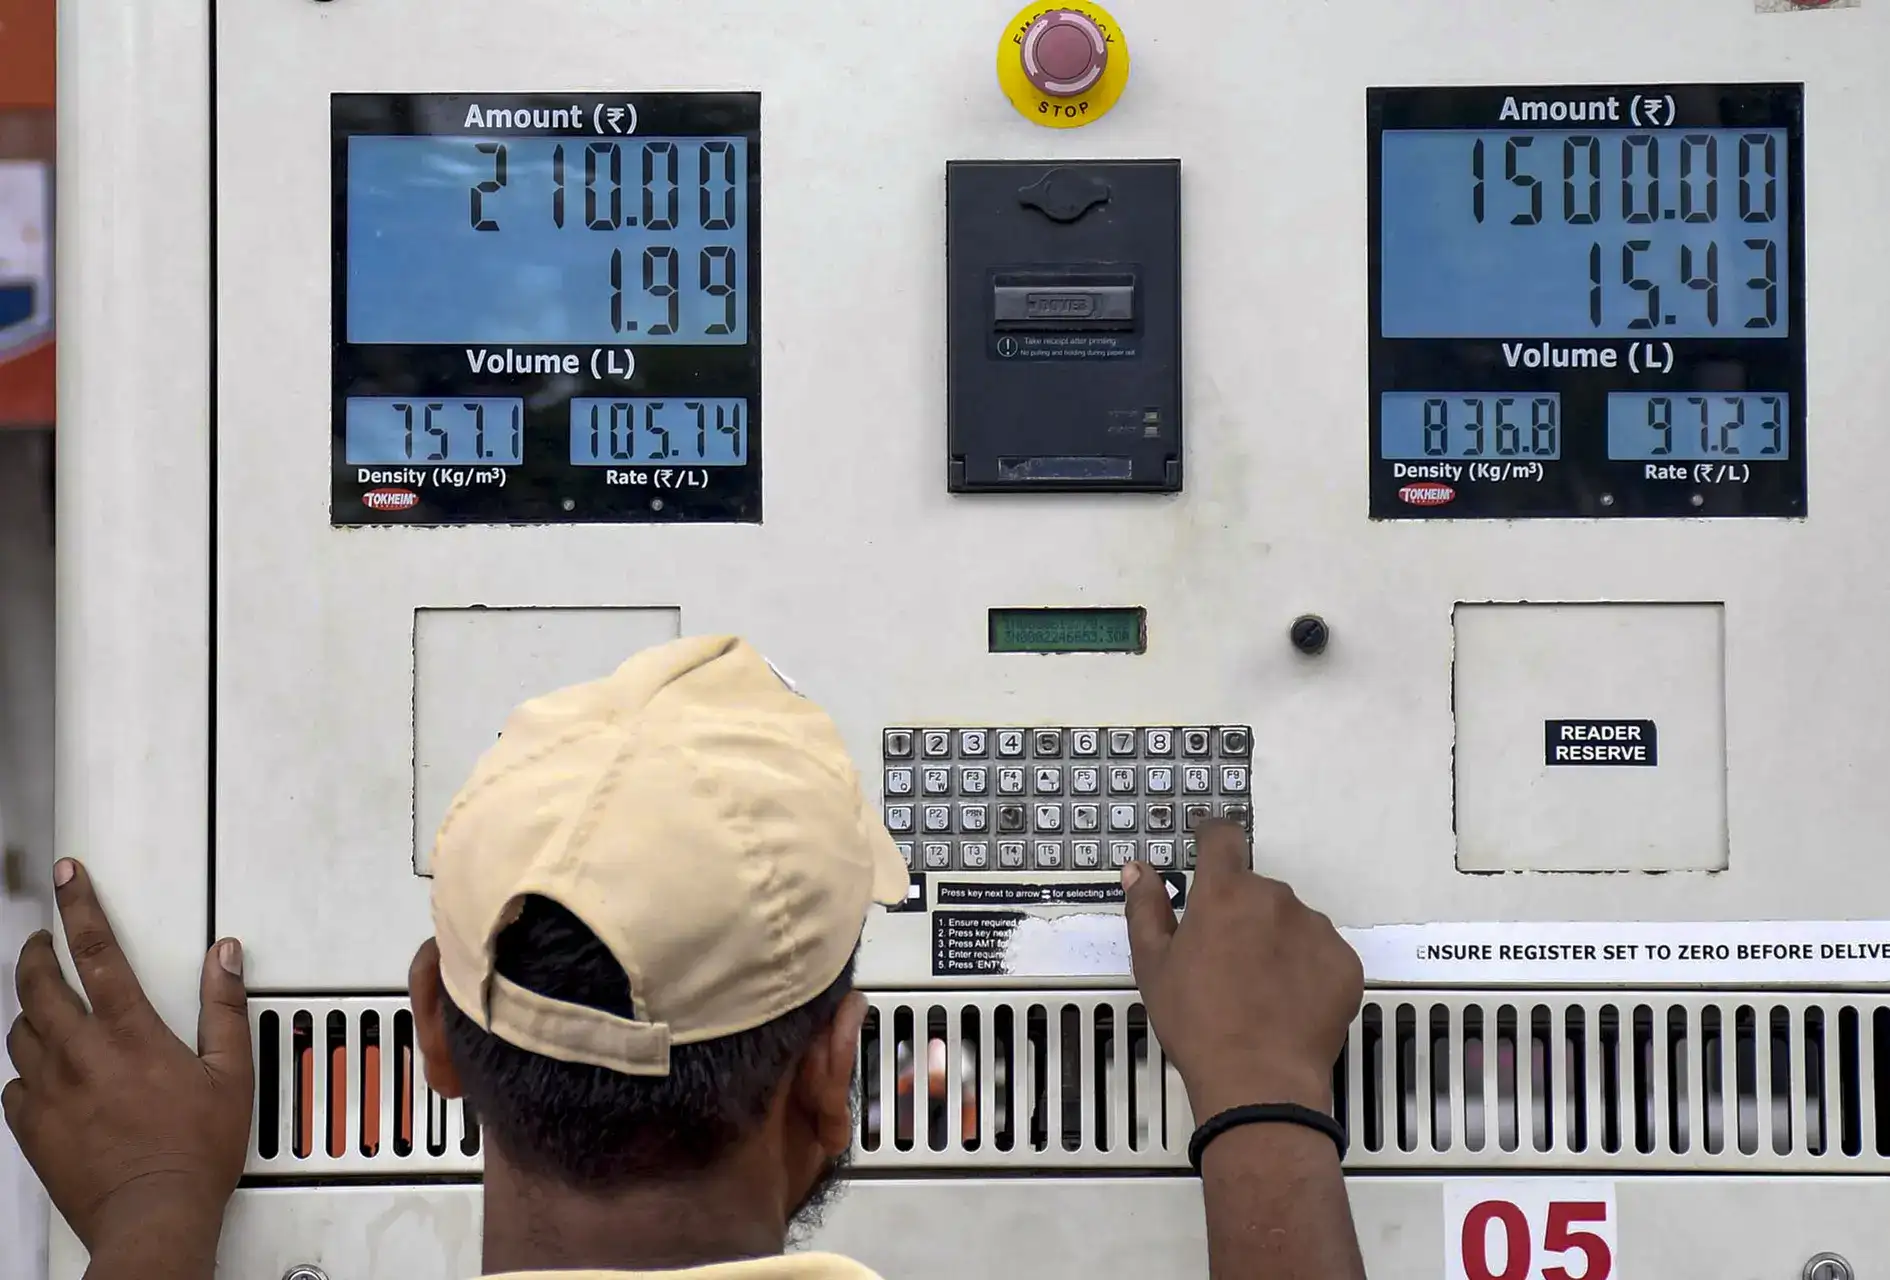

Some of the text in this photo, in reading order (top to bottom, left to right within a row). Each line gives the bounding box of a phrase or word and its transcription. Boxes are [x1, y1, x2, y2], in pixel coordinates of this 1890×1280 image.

[1038, 101, 1088, 118] STOP
[1500, 95, 1676, 127] Amount (₹)
[464, 103, 638, 134] Amount (₹)
[470, 142, 736, 231] 210.00
[1472, 133, 1776, 226] 1500.00
[610, 246, 736, 335] 1.99
[1589, 239, 1777, 329] 15.43
[1025, 337, 1042, 345] Take
[1070, 337, 1087, 345] after
[1089, 338, 1117, 348] printing
[466, 348, 635, 379] Volume (L)
[1502, 342, 1674, 373] Volume (L)
[393, 403, 519, 460] 757.1
[590, 402, 740, 459] 105.74
[1424, 398, 1555, 456] 836.8
[1647, 397, 1781, 455] 97.23
[358, 468, 426, 487] Density
[606, 470, 647, 485] Rate
[1393, 463, 1462, 481] Density
[1645, 464, 1687, 479] Rate
[364, 493, 417, 508] TOKHEIM
[1399, 488, 1453, 503] TOKHEIM
[1561, 726, 1641, 740] READER
[931, 736, 944, 752] 2
[968, 735, 980, 751] 3
[1005, 735, 1019, 750] 4
[1041, 734, 1055, 750] 5
[1079, 734, 1092, 750] 6
[1116, 733, 1129, 750] 7
[1153, 734, 1166, 750] 8
[1190, 733, 1204, 750] 9
[1556, 746, 1646, 760] RESERVE
[892, 770, 1239, 781] F1 F2 F3 F4 F5 F6 F7 F8 F9
[938, 783, 945, 791] W
[975, 782, 981, 790] E
[1012, 782, 1019, 790] R
[892, 810, 902, 818] P1
[929, 809, 942, 818] P2
[901, 820, 907, 828] A
[975, 820, 982, 828] D
[930, 845, 1167, 855] T2 T3 T4 T5 T6 T7 T8
[975, 857, 982, 865] C
[1013, 857, 1020, 865] V
[941, 888, 966, 897] Press
[968, 888, 982, 899] key
[985, 889, 1003, 897] next
[1005, 889, 1013, 897] to
[1052, 889, 1064, 897] for
[1066, 888, 1104, 899] selecting
[1106, 888, 1123, 896] side
[948, 918, 979, 927] Ensure
[981, 918, 1016, 928] required
[948, 929, 973, 937] Press
[975, 929, 991, 939] key
[948, 939, 973, 948] Press
[975, 939, 995, 947] AMT
[948, 950, 972, 958] Enter
[1416, 945, 1492, 960] ENSURE
[1499, 945, 1596, 960] REGISTER
[1603, 945, 1638, 960] SET
[1645, 945, 1671, 960] TO
[1678, 944, 1729, 960] ZERO
[1737, 944, 1813, 959] BEFORE
[948, 960, 973, 969] Press
[1461, 1200, 1611, 1280] 05
